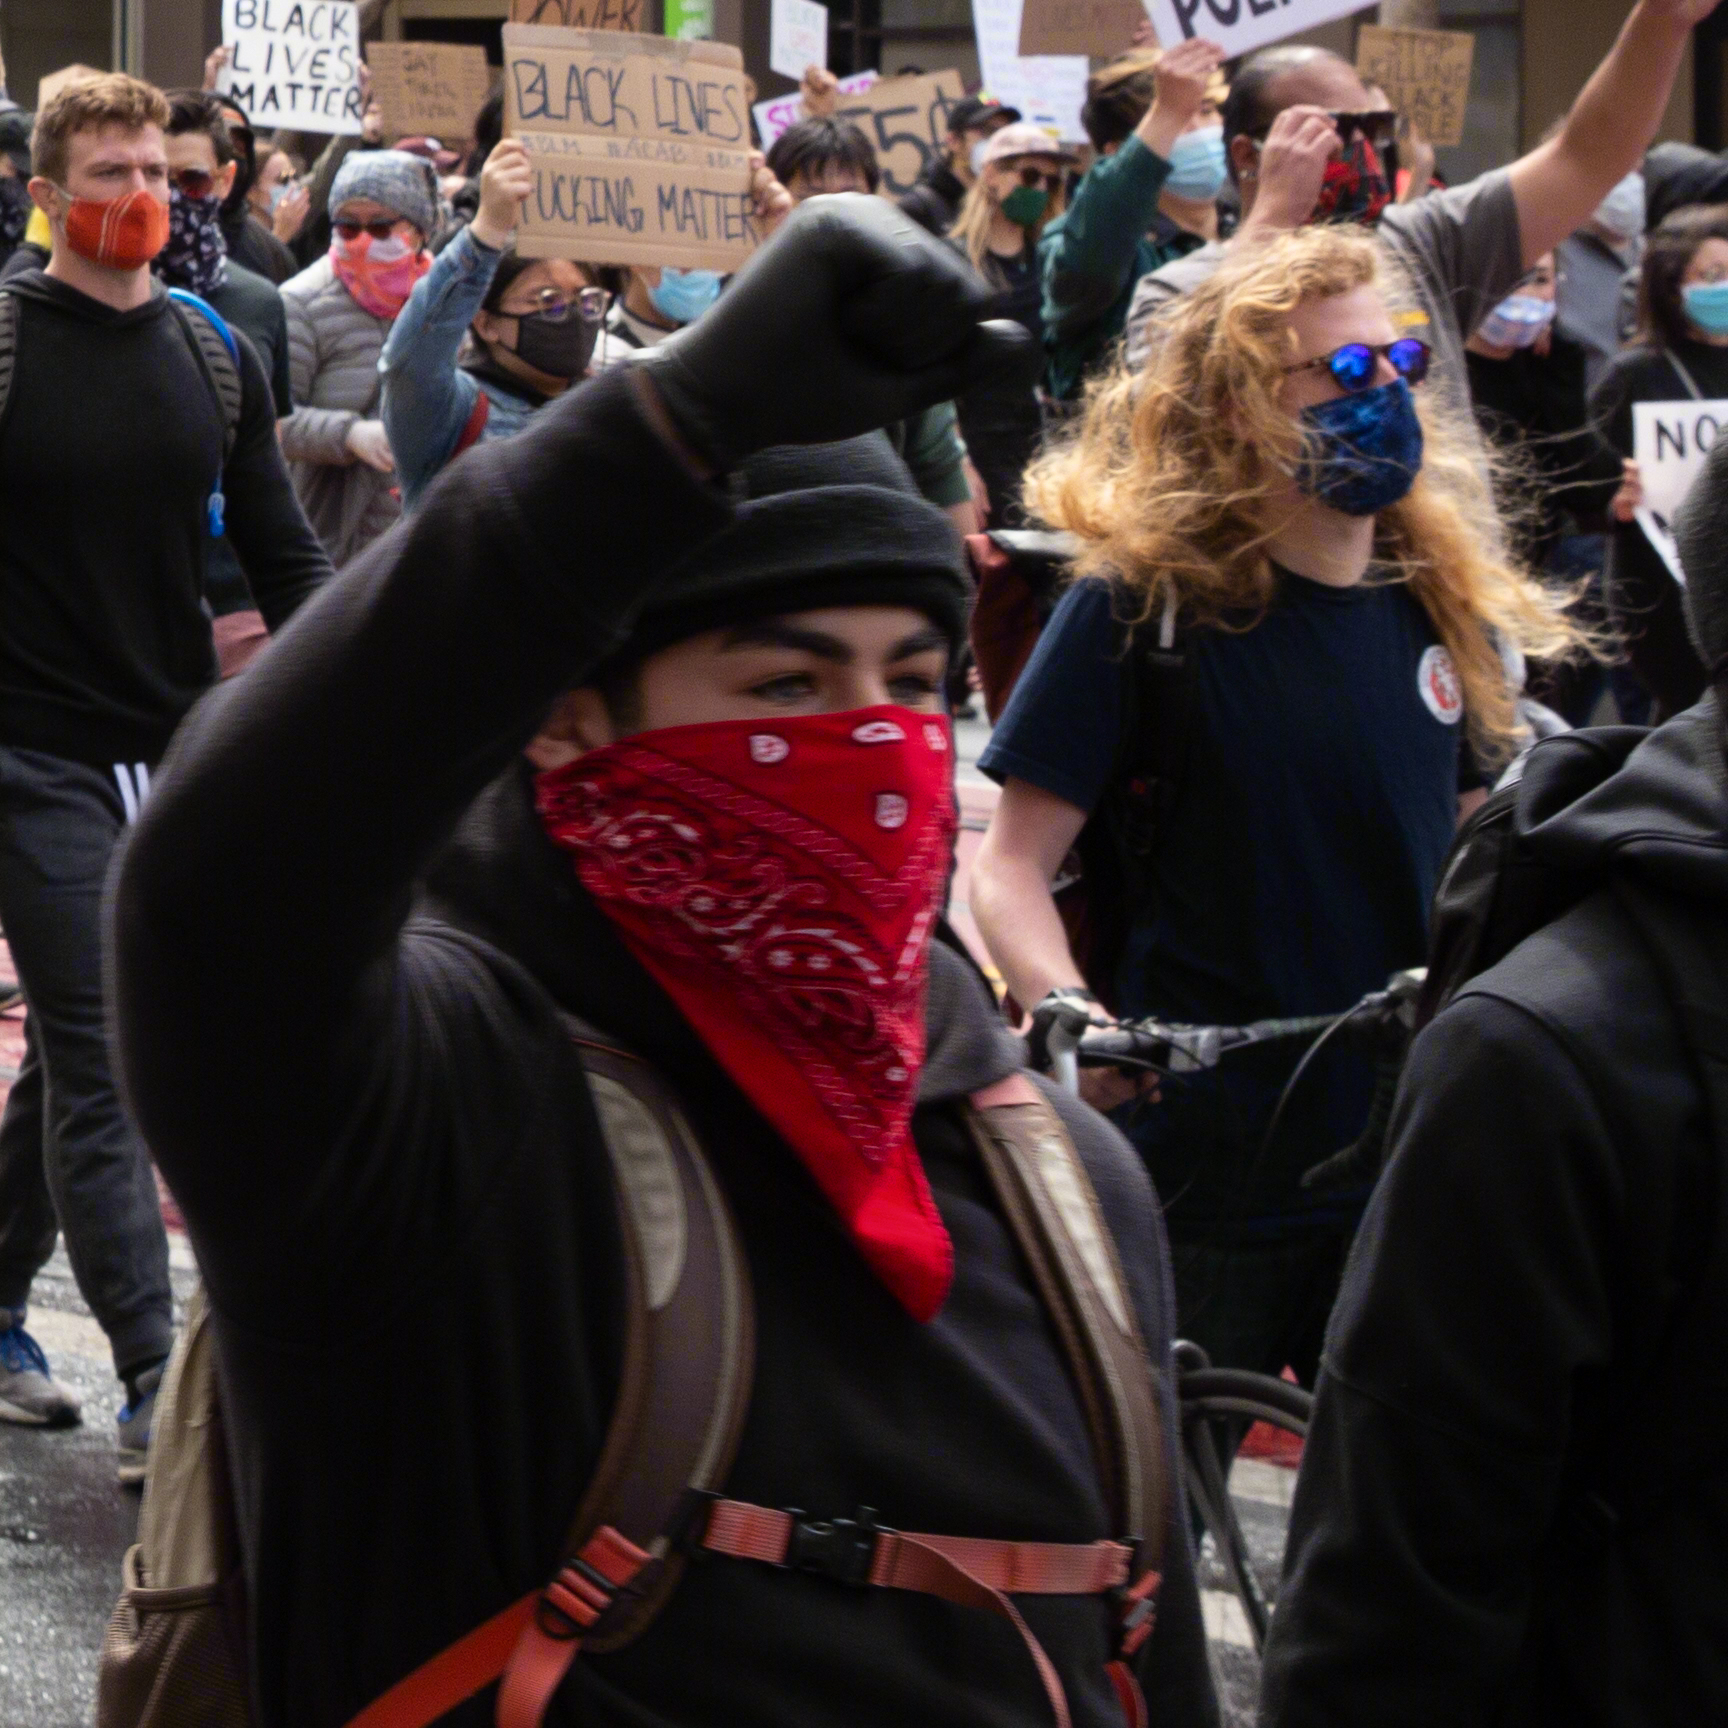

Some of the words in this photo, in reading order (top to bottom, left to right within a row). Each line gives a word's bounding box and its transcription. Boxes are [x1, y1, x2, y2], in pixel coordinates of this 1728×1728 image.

[231, 41, 354, 83] LIVES
[230, 83, 363, 120] MATTER
[512, 59, 639, 133] BLACK
[652, 73, 743, 143] LIVES
[656, 182, 759, 247] MATTER
